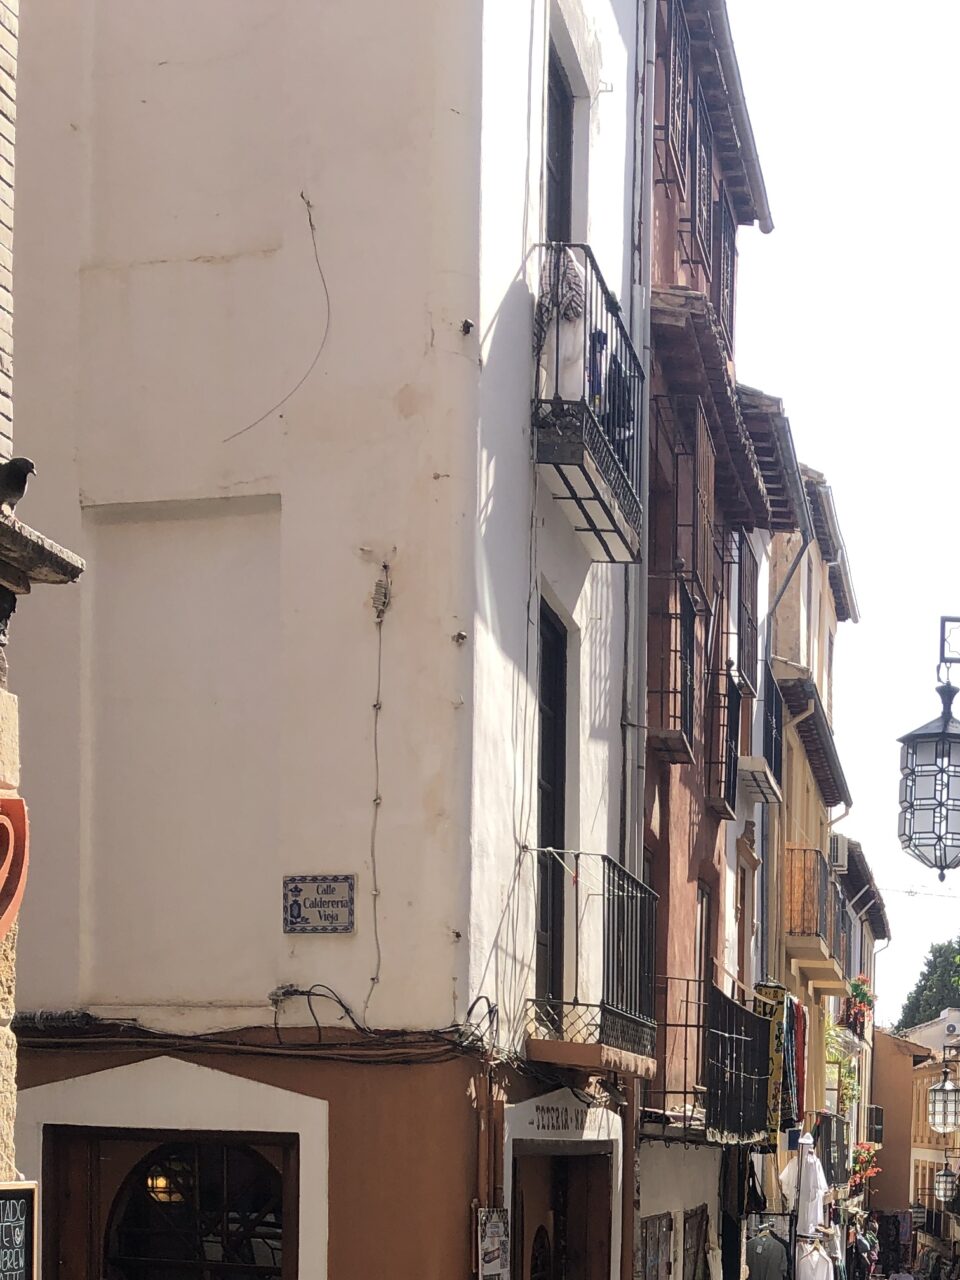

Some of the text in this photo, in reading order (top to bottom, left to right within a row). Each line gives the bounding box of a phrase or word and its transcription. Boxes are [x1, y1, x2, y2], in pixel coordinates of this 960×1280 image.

[316, 884, 336, 895] Calle
[303, 896, 348, 909] Calderería
[318, 910, 338, 924] Vieja
